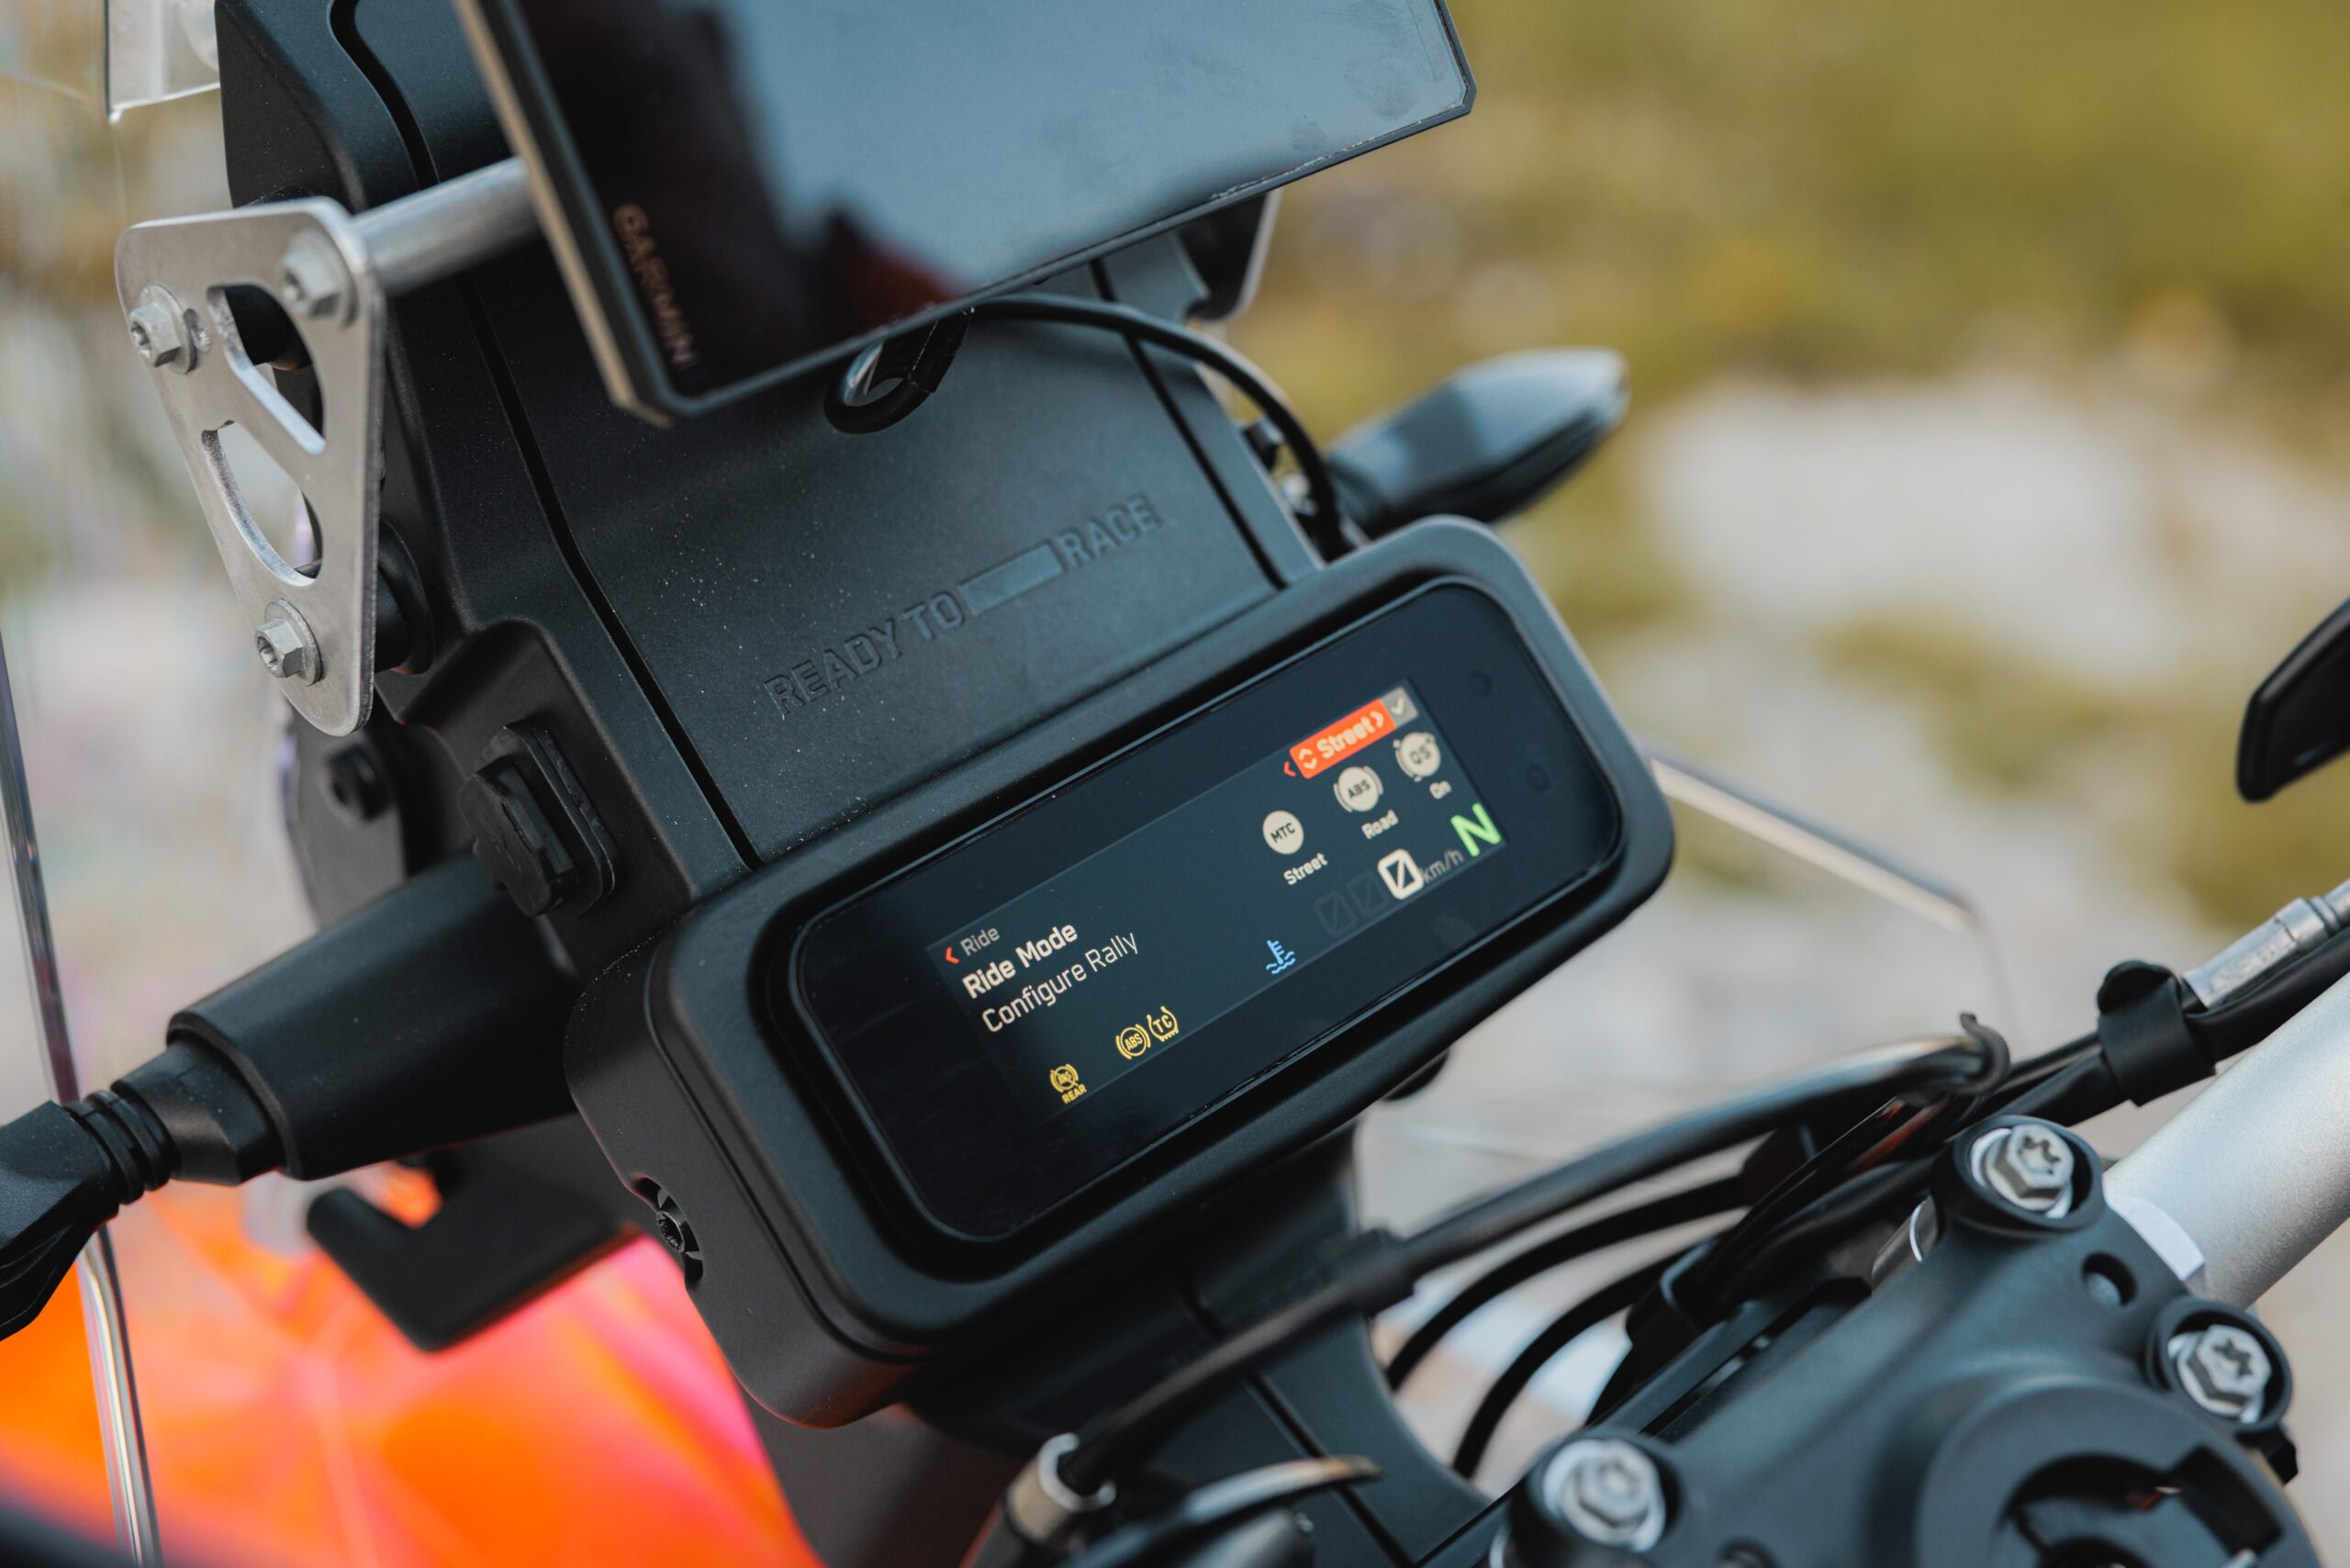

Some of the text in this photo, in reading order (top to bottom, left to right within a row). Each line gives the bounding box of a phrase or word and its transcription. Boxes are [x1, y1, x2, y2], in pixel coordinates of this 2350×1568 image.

[613, 203, 699, 370] GARMIN
[764, 493, 1164, 716] READY TO RACE
[1316, 716, 1376, 759] Street
[1347, 780, 1371, 800] ABS
[1270, 822, 1296, 844] MTC
[1361, 809, 1399, 839] Road
[1450, 801, 1502, 857] N
[1283, 853, 1328, 885] Street
[1421, 848, 1464, 884] km/h
[960, 926, 1001, 957] Ride
[962, 923, 1078, 999] Ride Mode
[981, 932, 1139, 1033] Configure Rally
[1124, 1032, 1144, 1051] ABS
[1061, 1083, 1088, 1104] REAR
